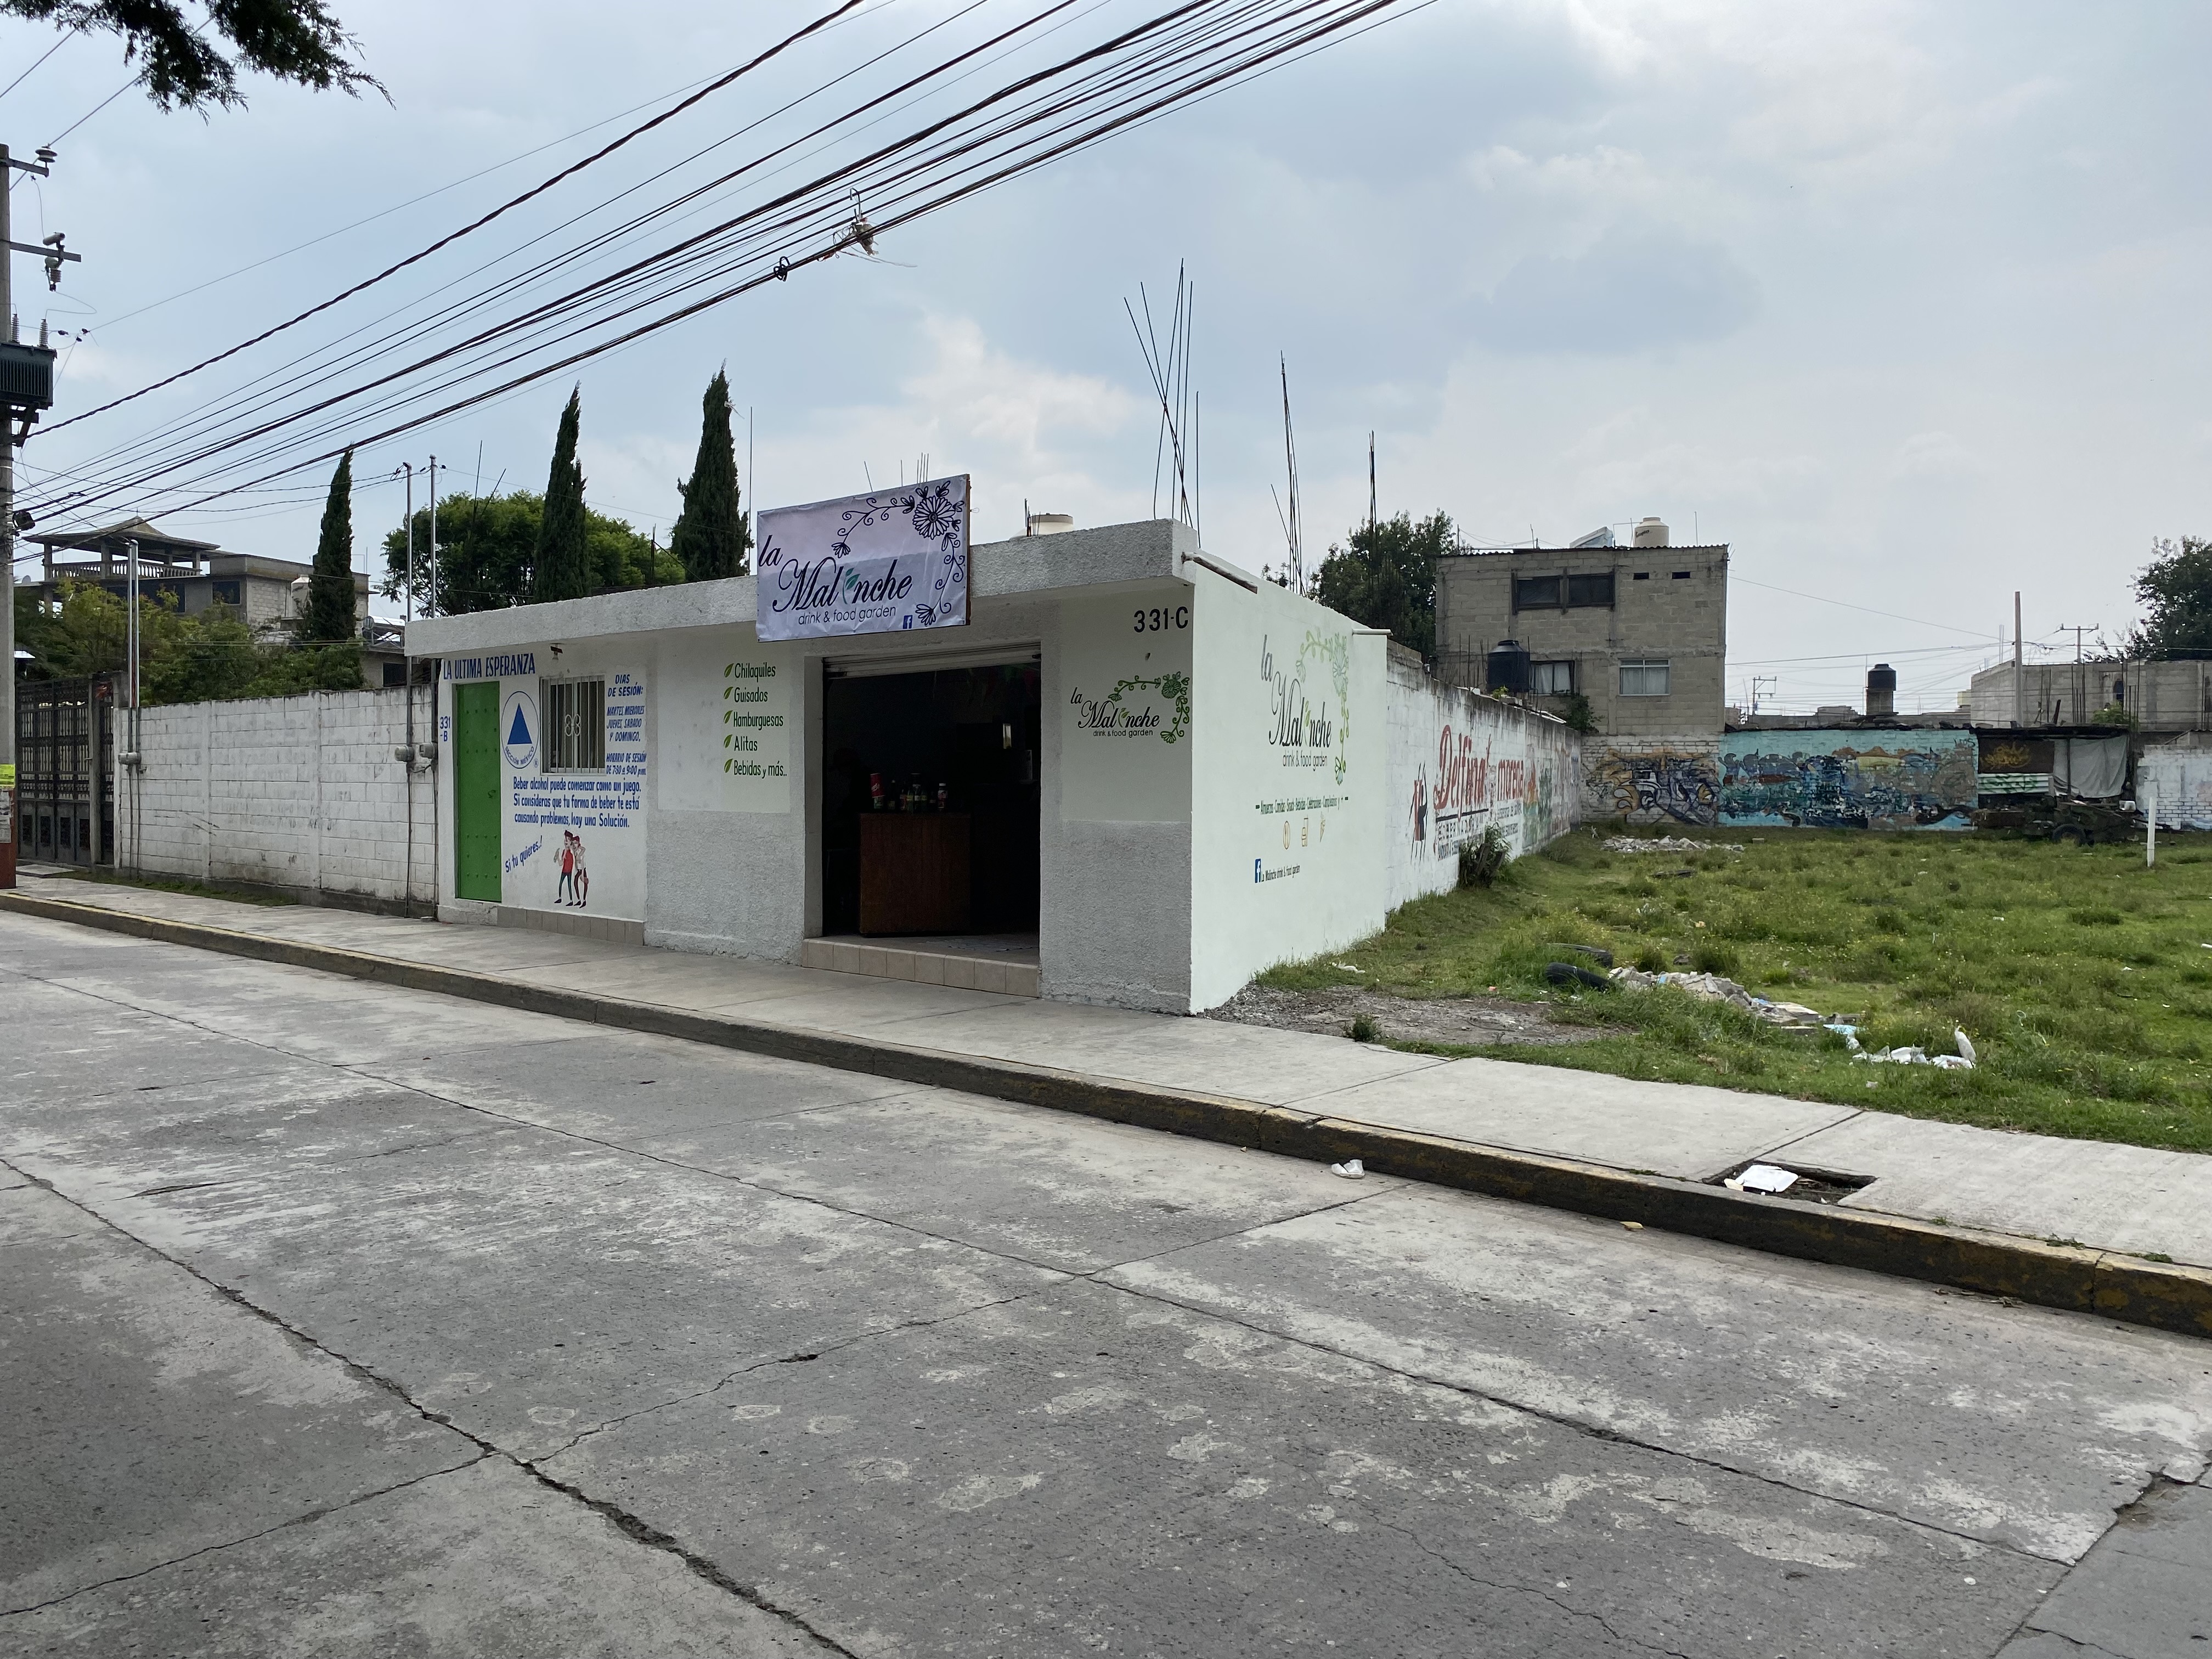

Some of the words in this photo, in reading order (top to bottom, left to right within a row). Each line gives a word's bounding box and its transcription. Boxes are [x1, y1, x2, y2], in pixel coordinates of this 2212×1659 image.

[758, 534, 783, 567] la
[772, 556, 912, 612] Malinche
[799, 612, 821, 625] drink
[823, 611, 830, 623] &
[833, 608, 856, 622] food
[859, 605, 896, 622] garden
[1133, 606, 1188, 633] 331-C
[443, 660, 452, 680] LA
[455, 658, 482, 679] ULTIMA
[486, 653, 535, 677] ESPERANZA
[1261, 634, 1273, 682] la
[615, 674, 630, 684] DIAS
[735, 662, 776, 682] Chilaquiles
[608, 687, 616, 697] DE
[618, 681, 644, 696] SESIÓN:
[734, 687, 768, 703] Guisados
[1070, 687, 1083, 704] la
[607, 706, 624, 716] MARTES,
[624, 706, 645, 715] MIERCOLES
[1078, 700, 1160, 729] Malinche
[1269, 671, 1331, 748] Malinche
[440, 715, 450, 729] 331
[607, 719, 623, 729] JUEVES,
[624, 718, 642, 728] SABADO
[733, 712, 783, 731] Hamburguesas
[610, 732, 613, 742] Y
[615, 731, 641, 742] DOMINGO.
[1128, 729, 1153, 738] garden
[734, 736, 758, 751] Alitas
[505, 746, 519, 765] SECCIÓN
[520, 746, 534, 765] MÉXICO
[606, 753, 624, 763] HORARIO
[625, 753, 631, 763] DE
[632, 750, 647, 763] SESIÓN
[1283, 749, 1295, 767] drink
[1295, 750, 1300, 767] &
[1301, 749, 1311, 767] food
[1312, 749, 1327, 771] garden
[606, 765, 612, 775] DE
[613, 765, 622, 775] 7:30
[626, 765, 637, 775] 9:00
[734, 760, 761, 775] Bebidas
[763, 769, 766, 778] y
[514, 776, 529, 789] Beber
[530, 777, 549, 790] alcohol
[550, 777, 566, 793] puede
[568, 781, 595, 791] comenzar
[596, 781, 612, 791] como
[613, 782, 621, 791] un
[622, 777, 641, 795] juego.
[1497, 759, 1523, 801] morena
[514, 793, 520, 806] Si
[522, 793, 551, 808] consideras
[552, 798, 562, 810] que
[563, 794, 570, 808] tu
[572, 794, 589, 809] forma
[591, 795, 597, 809] de
[599, 795, 616, 809] beber
[618, 795, 624, 809] te
[625, 795, 640, 810] está
[515, 810, 539, 823] causando
[541, 811, 571, 827] problemas,
[571, 812, 582, 828] hay
[585, 816, 596, 826] una
[599, 813, 629, 828] Solución.
[505, 858, 511, 873] Si
[512, 854, 518, 868] tu
